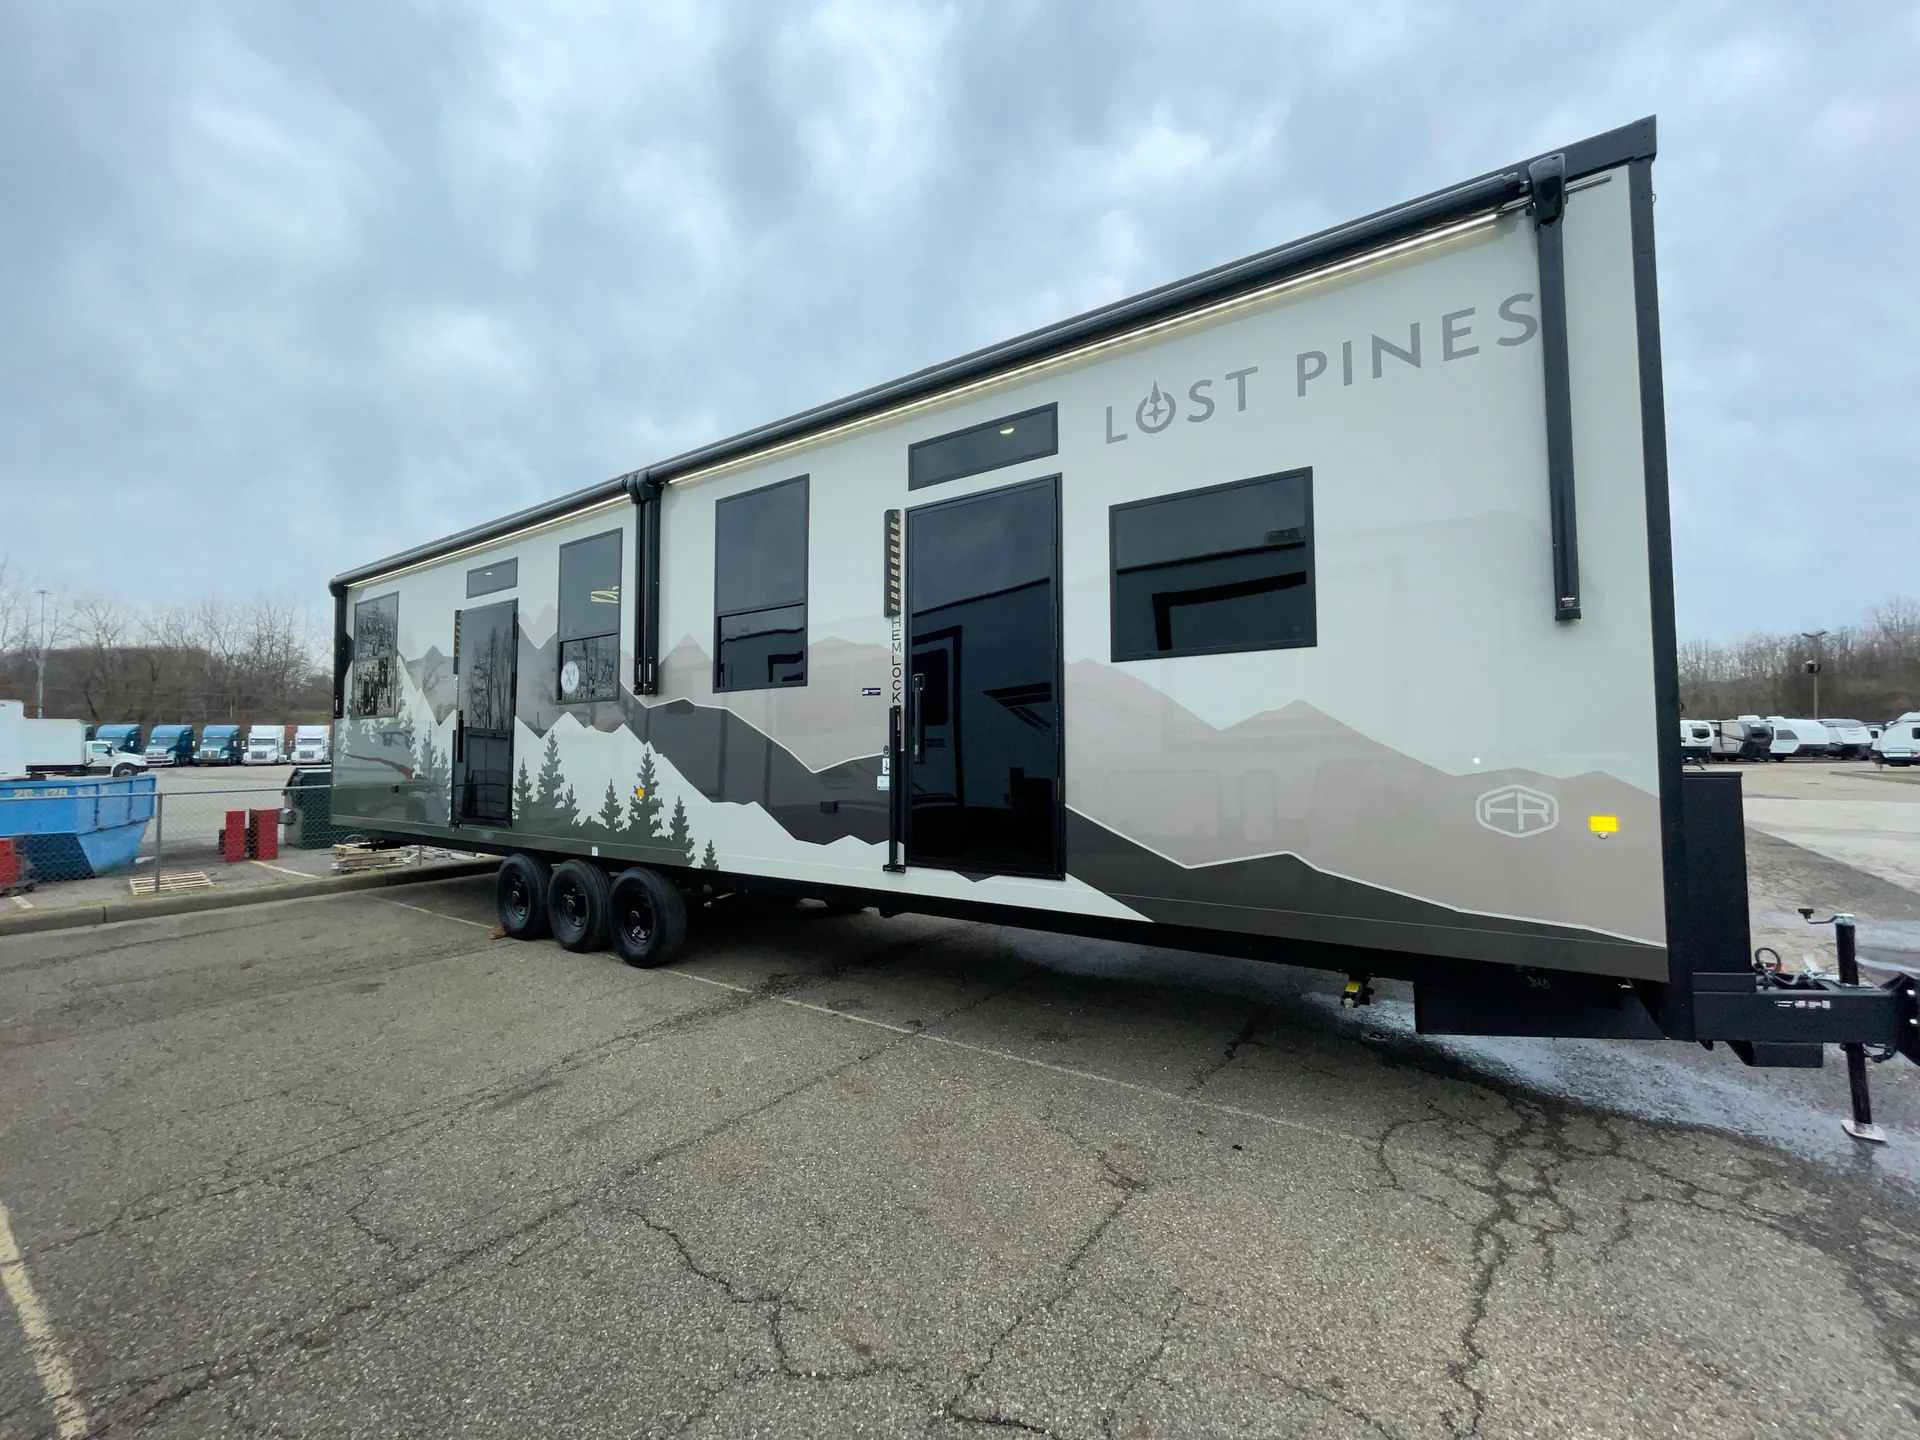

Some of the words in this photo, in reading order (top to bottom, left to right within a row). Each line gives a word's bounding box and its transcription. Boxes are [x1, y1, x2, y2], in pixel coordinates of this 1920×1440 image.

[1105, 366, 1258, 444] LOST
[1296, 292, 1539, 398] PINES
[891, 616, 902, 704] HEMLOCK
